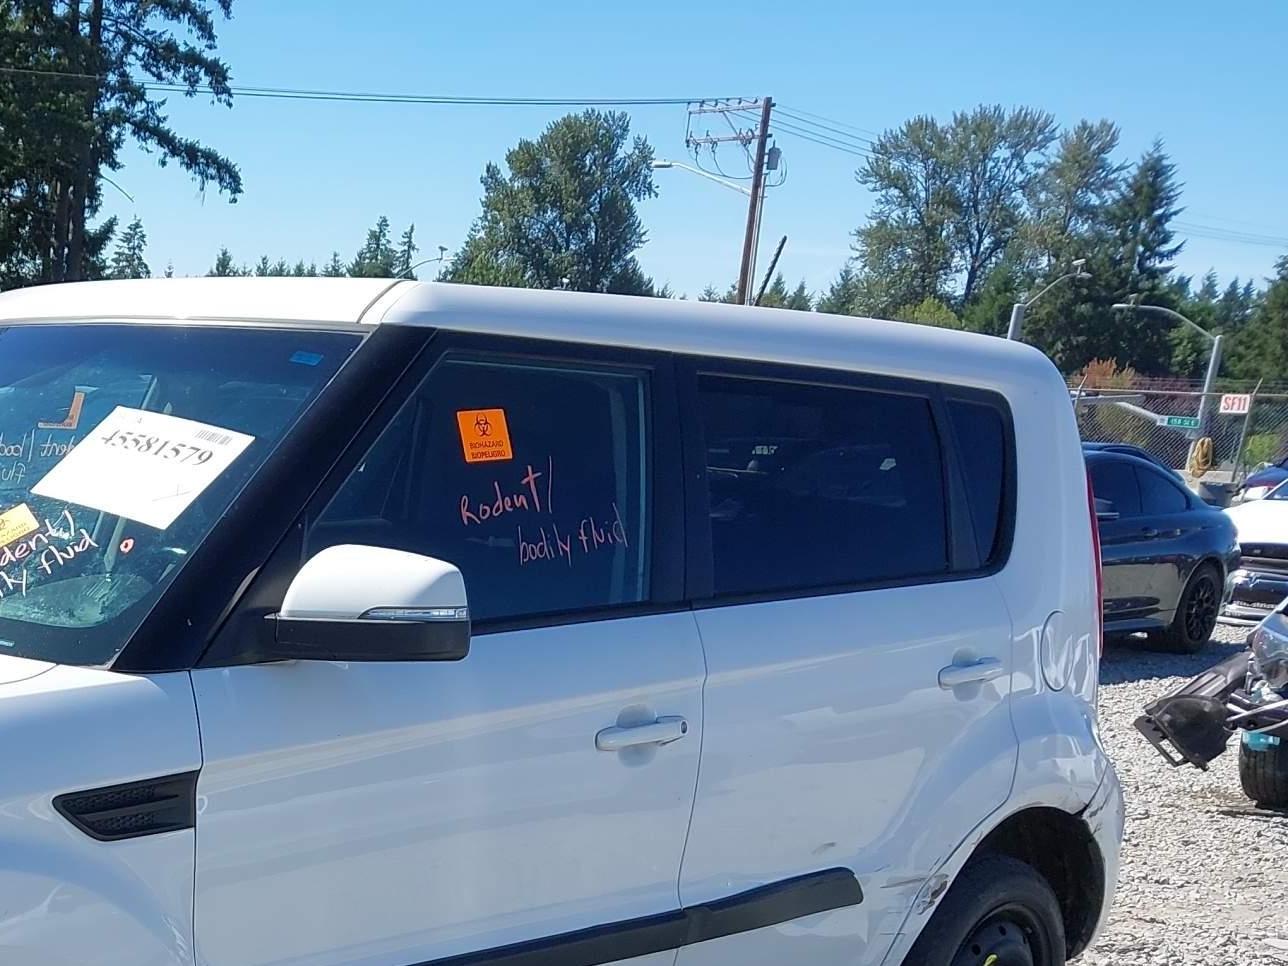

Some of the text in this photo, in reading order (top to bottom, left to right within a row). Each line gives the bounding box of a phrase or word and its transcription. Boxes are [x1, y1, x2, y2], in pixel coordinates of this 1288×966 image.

[1222, 396, 1248, 411] SF11
[100, 428, 214, 466] 45581579
[37, 528, 99, 575] fluid
[517, 502, 628, 566] bodily fluid
